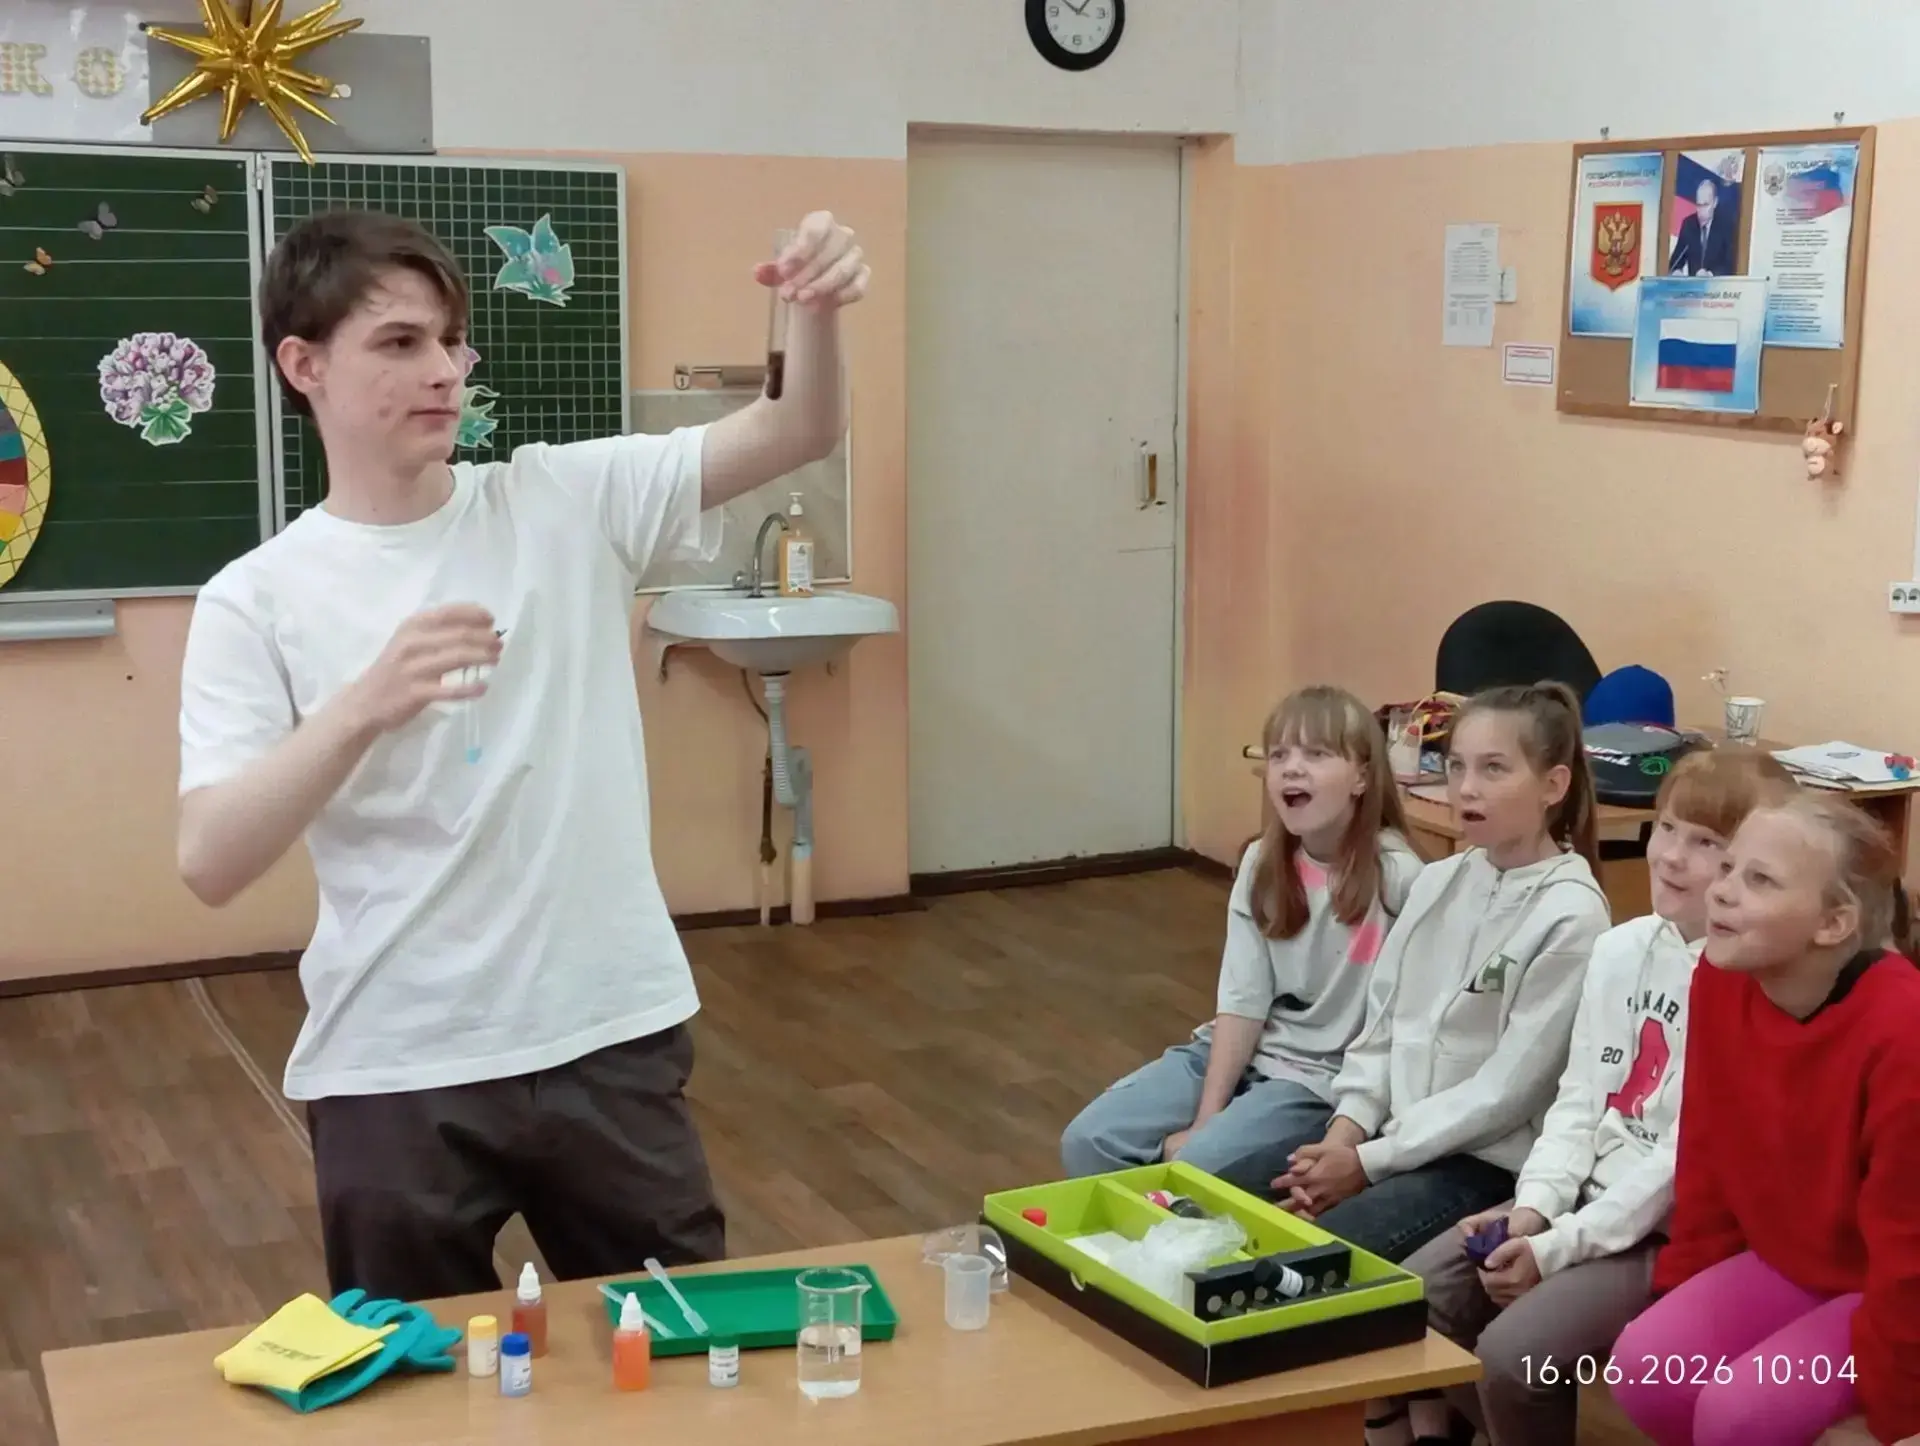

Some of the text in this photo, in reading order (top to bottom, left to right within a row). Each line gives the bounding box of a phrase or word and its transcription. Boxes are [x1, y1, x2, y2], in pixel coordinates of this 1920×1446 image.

[1048, 6, 1059, 17] 9
[1096, 7, 1106, 19] 3
[1072, 35, 1082, 45] 6
[1600, 1046, 1624, 1065] 20
